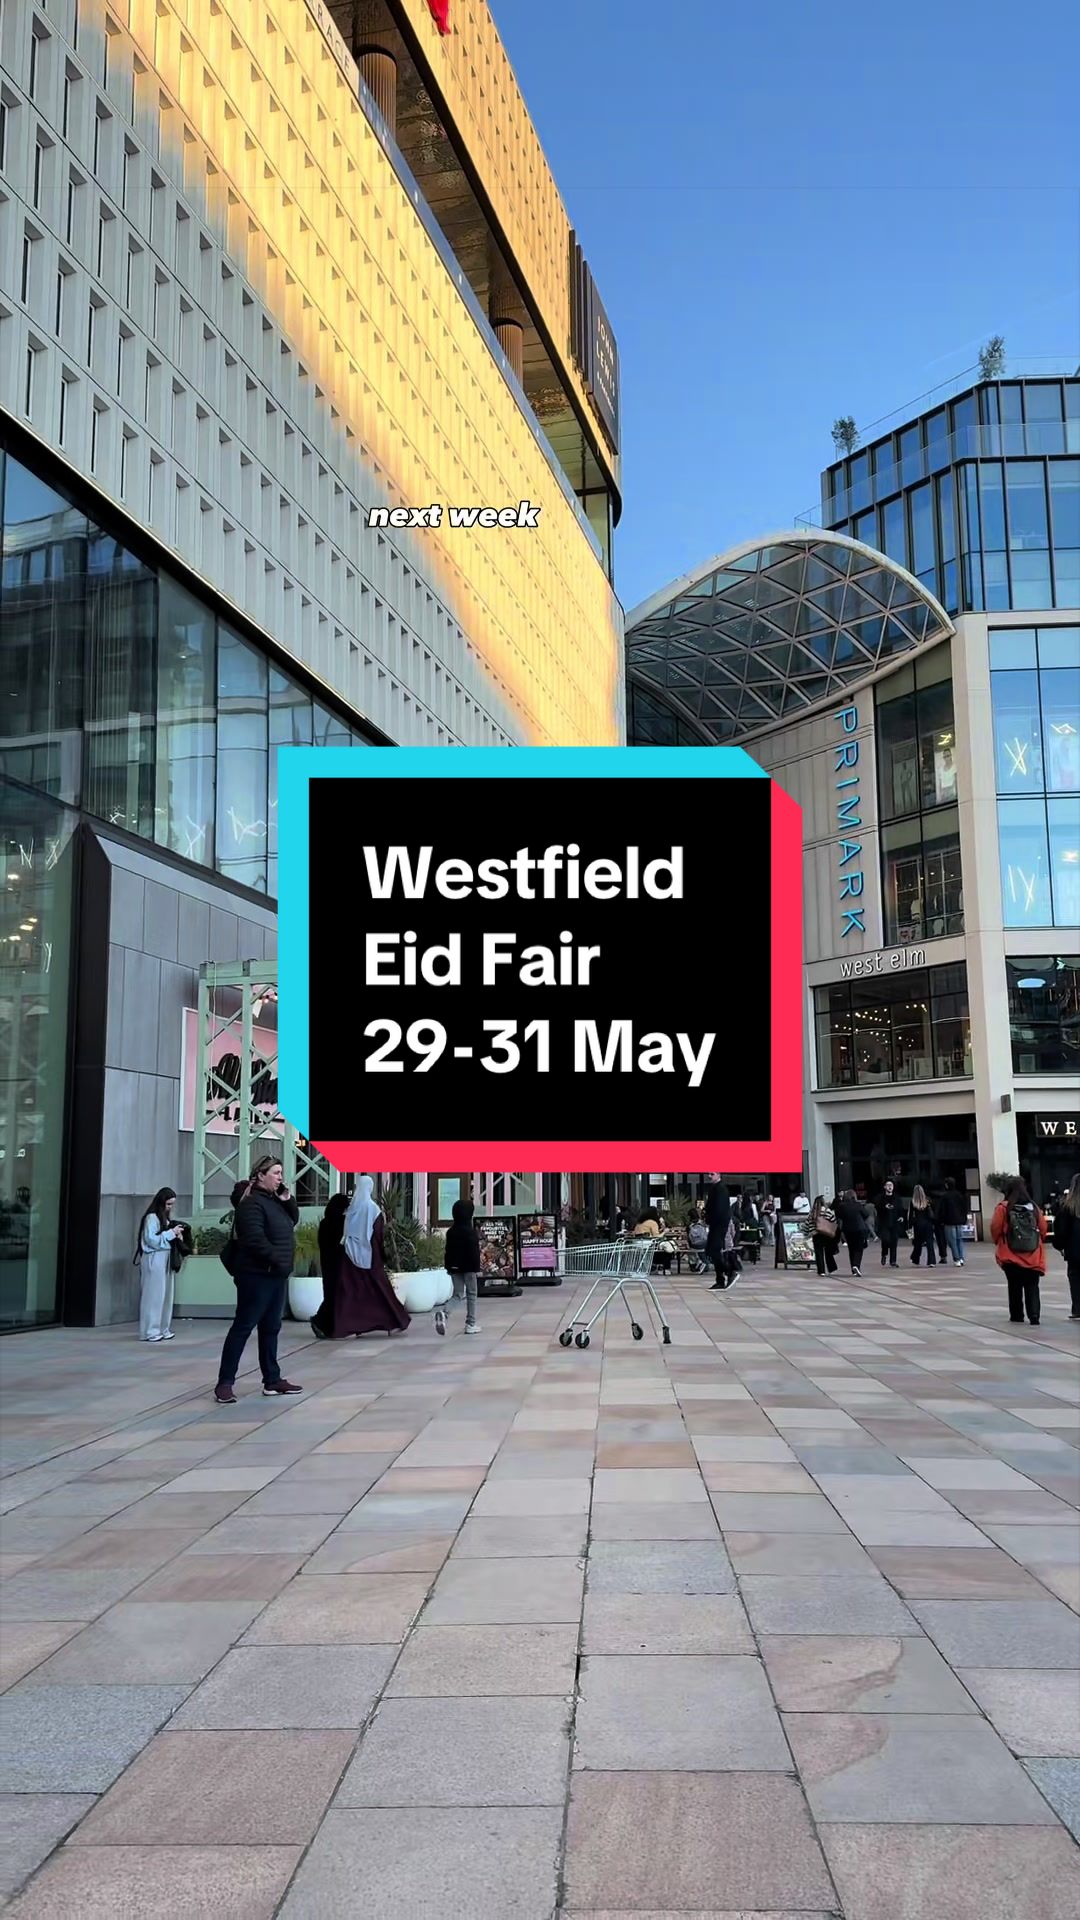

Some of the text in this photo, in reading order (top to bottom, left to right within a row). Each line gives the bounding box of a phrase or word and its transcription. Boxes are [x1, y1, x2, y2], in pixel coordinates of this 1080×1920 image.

[597, 315, 614, 365] JOHN
[596, 340, 615, 397] LEWIS
[834, 706, 866, 938] PRIMARK
[840, 948, 926, 978] west elm
